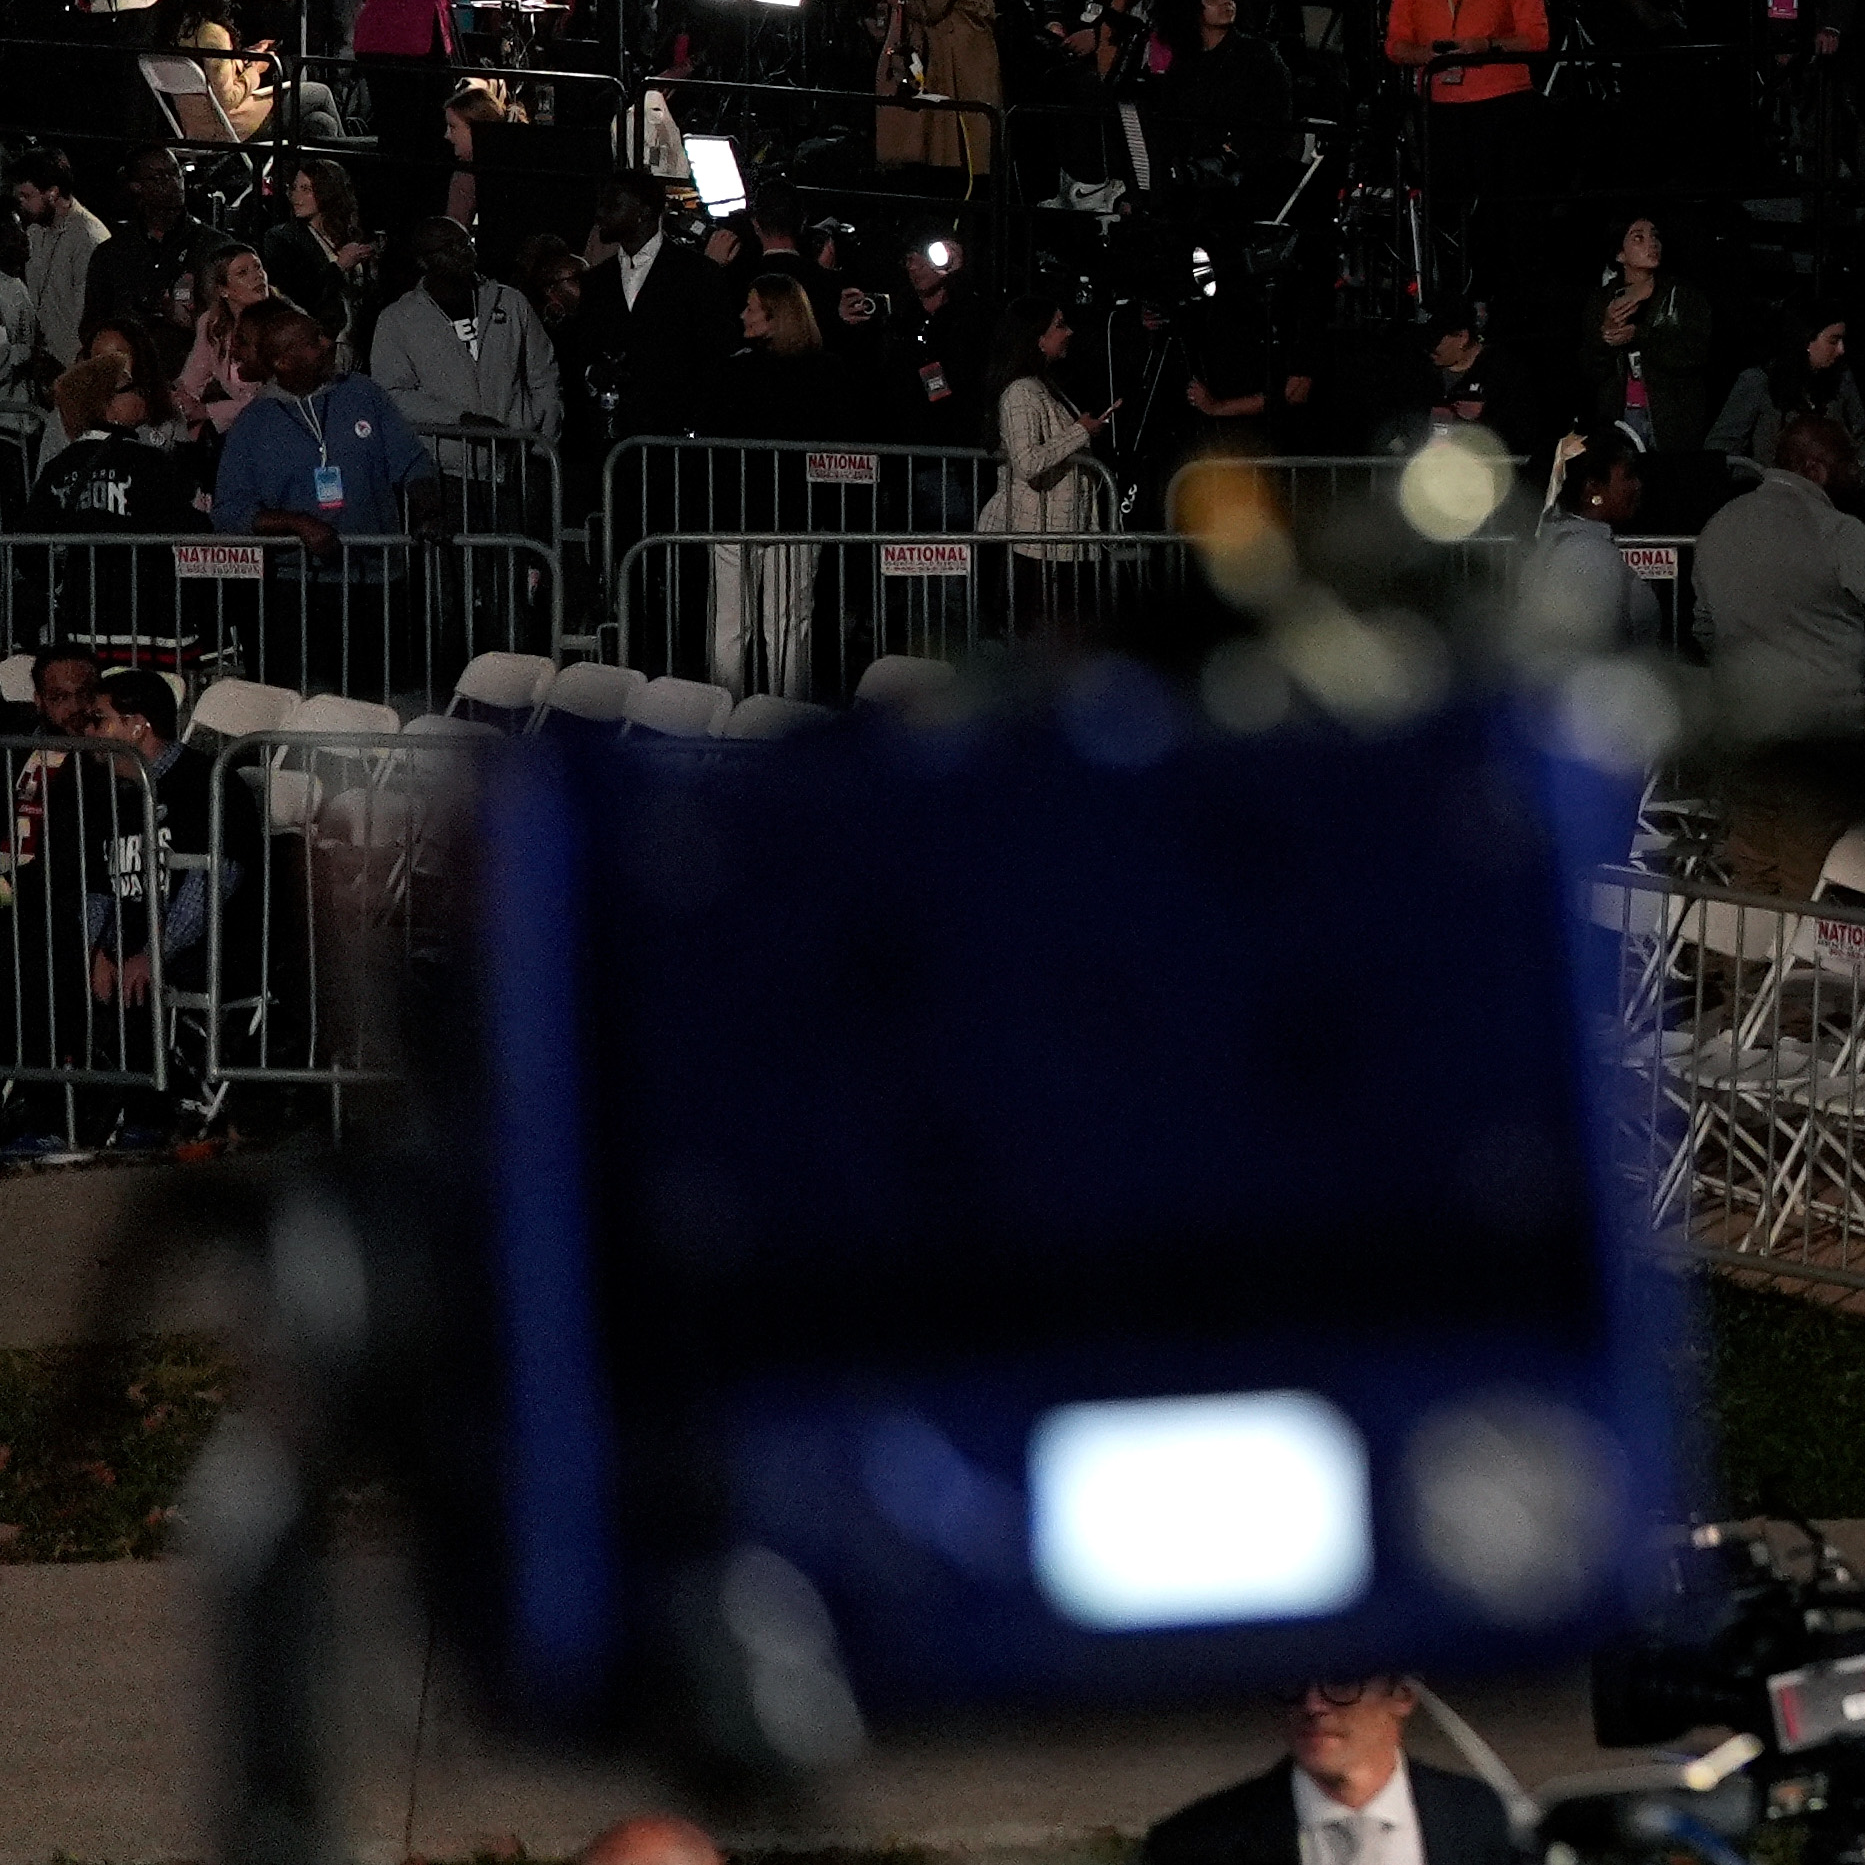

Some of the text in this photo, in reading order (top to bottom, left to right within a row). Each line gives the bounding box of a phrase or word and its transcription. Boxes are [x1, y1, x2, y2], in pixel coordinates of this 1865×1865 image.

[809, 454, 874, 470] NATIONAL
[178, 547, 260, 564] NATIONAL
[884, 546, 966, 562] NATIONAL
[1625, 549, 1675, 566] IONAL
